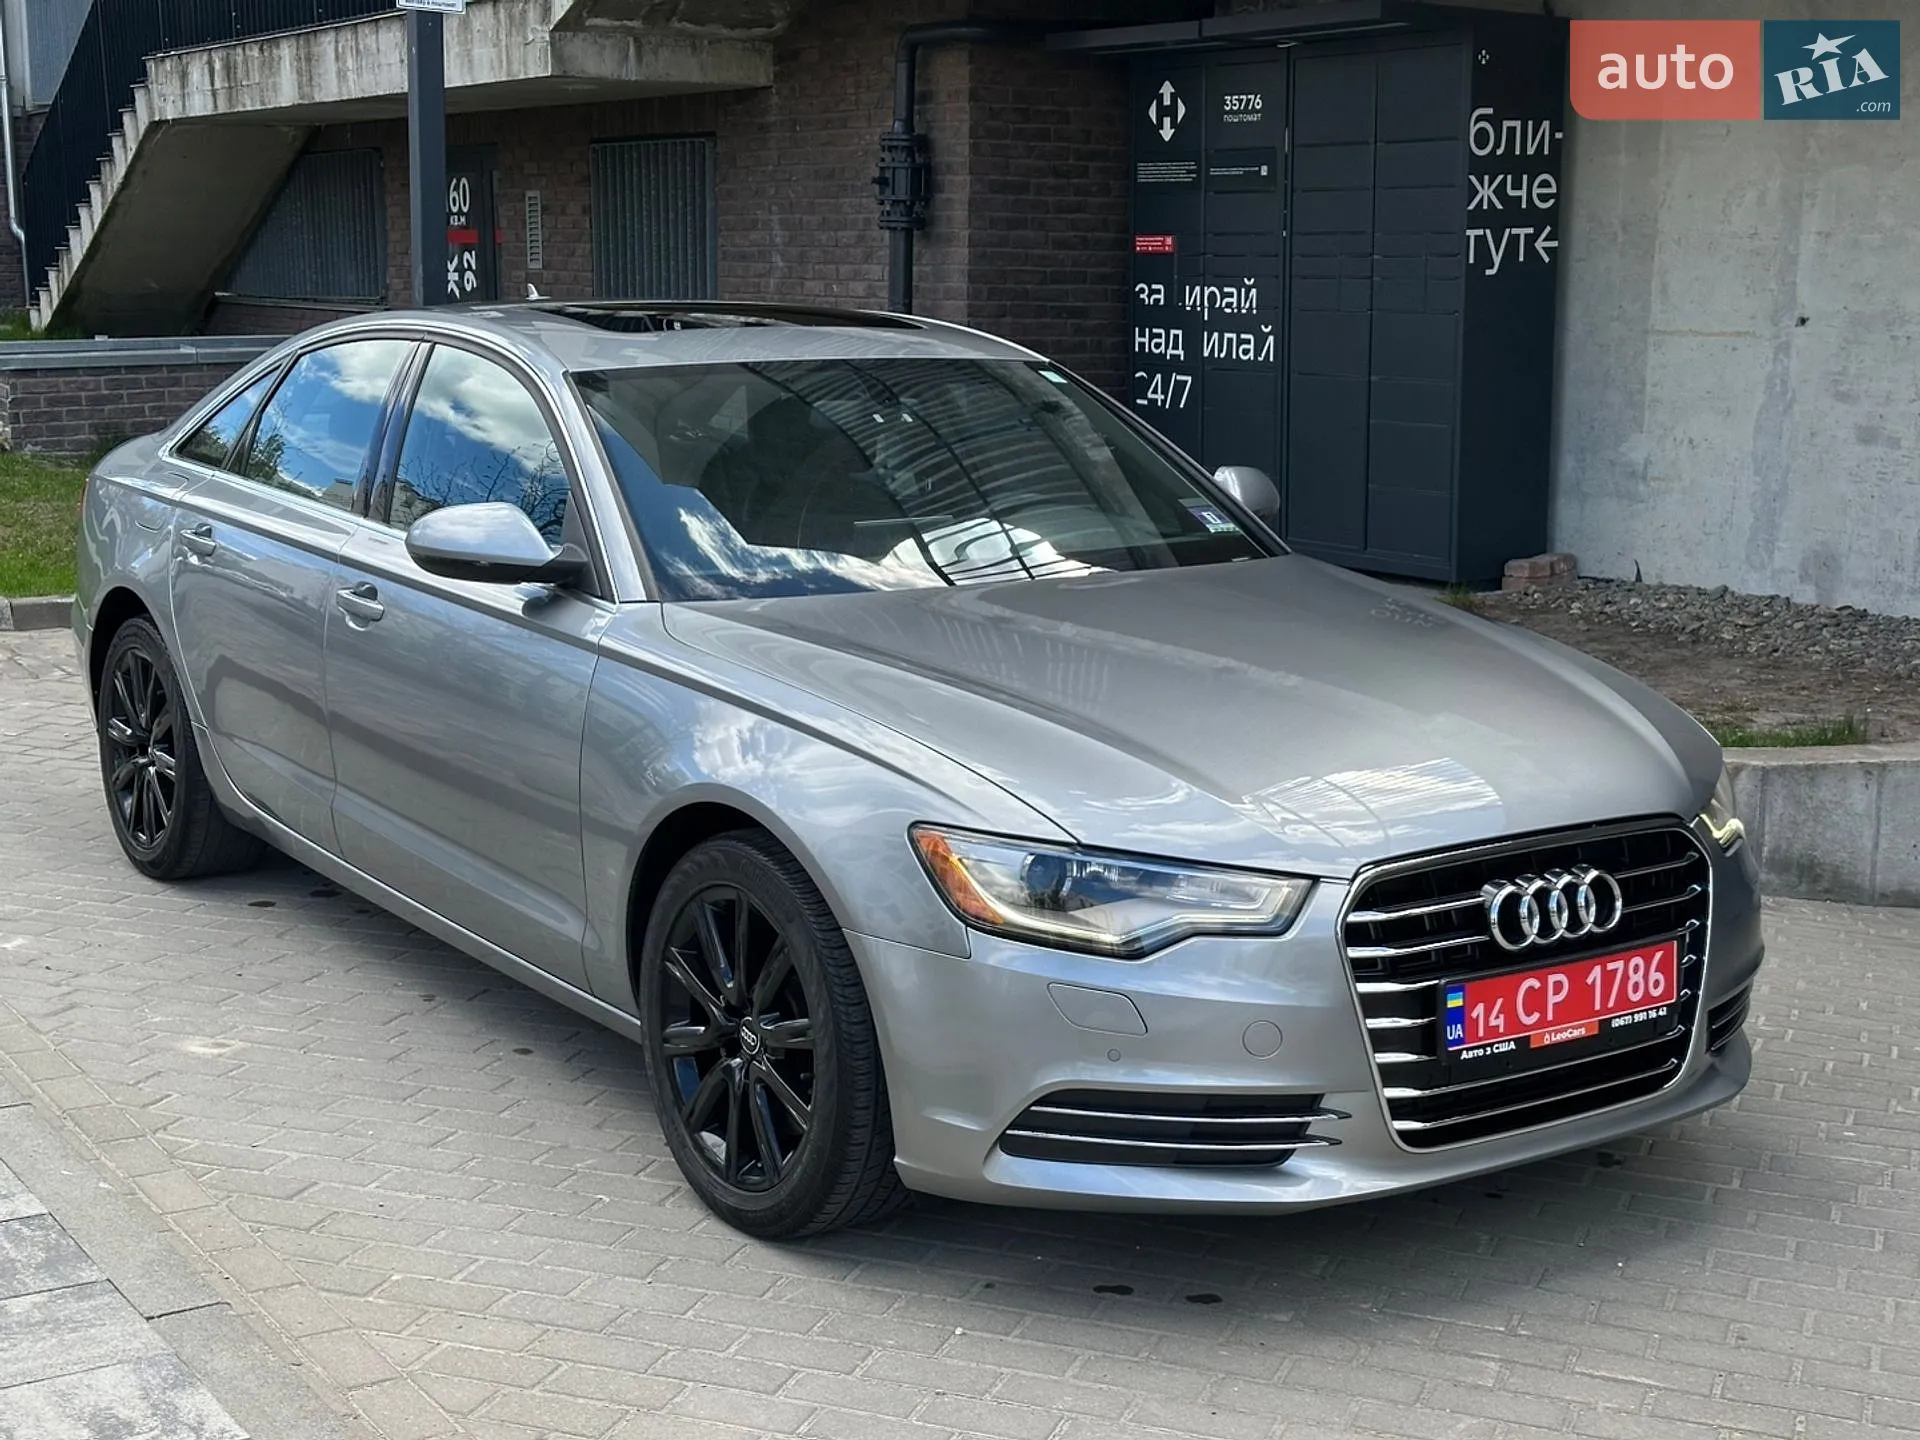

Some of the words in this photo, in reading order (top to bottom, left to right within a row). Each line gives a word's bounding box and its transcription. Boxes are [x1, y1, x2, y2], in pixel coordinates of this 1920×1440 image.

[1224, 94, 1263, 110] 35776
[1469, 107, 1564, 156] бли-
[1467, 173, 1558, 210] жче
[1465, 227, 1535, 276] тут
[1134, 324, 1275, 362] надилай
[1470, 999, 1505, 1038] 14
[1515, 973, 1570, 1026] CP
[1585, 950, 1665, 1011] 1786
[1446, 1024, 1464, 1040] UA
[1551, 1026, 1586, 1041] LeoCars
[1611, 1015, 1633, 1028] (067)
[1460, 1047, 1484, 1060] Авто
[1493, 1040, 1517, 1053] США
